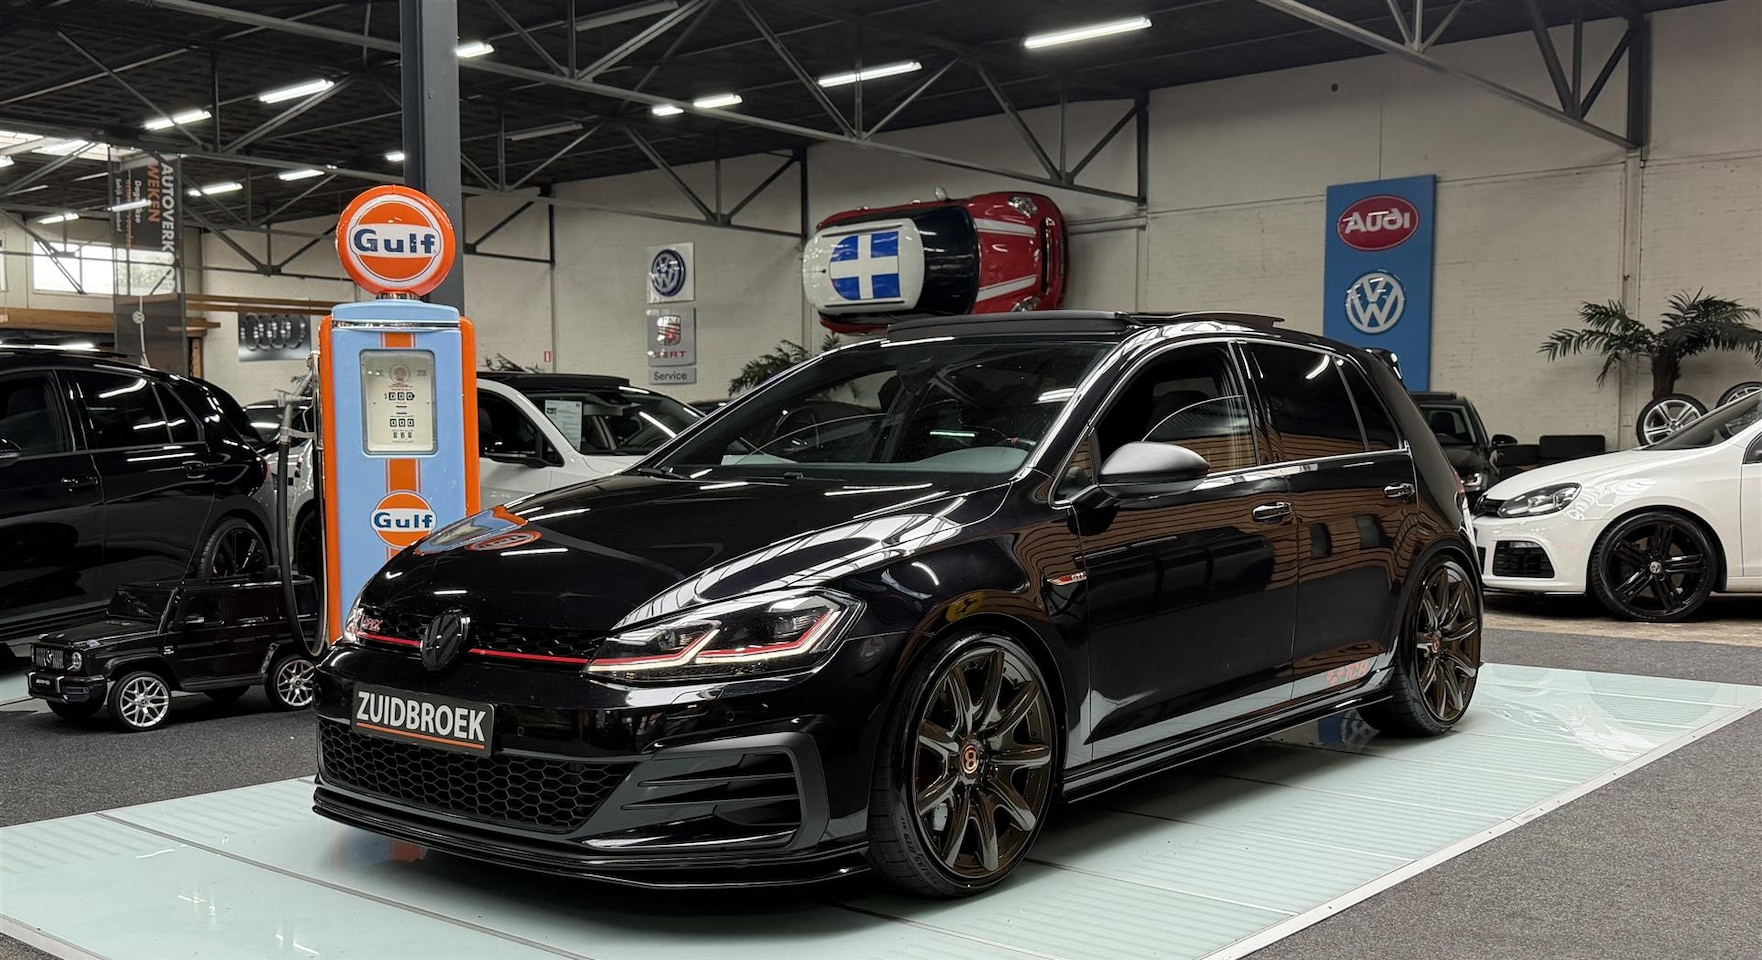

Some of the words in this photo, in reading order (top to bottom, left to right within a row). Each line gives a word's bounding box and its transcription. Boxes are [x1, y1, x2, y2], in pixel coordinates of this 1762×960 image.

[354, 229, 436, 254] Gulf
[654, 371, 687, 380] Service
[374, 512, 433, 529] Gulf
[1346, 661, 1369, 680] TCR
[356, 691, 486, 742] ZUIDBROEK
